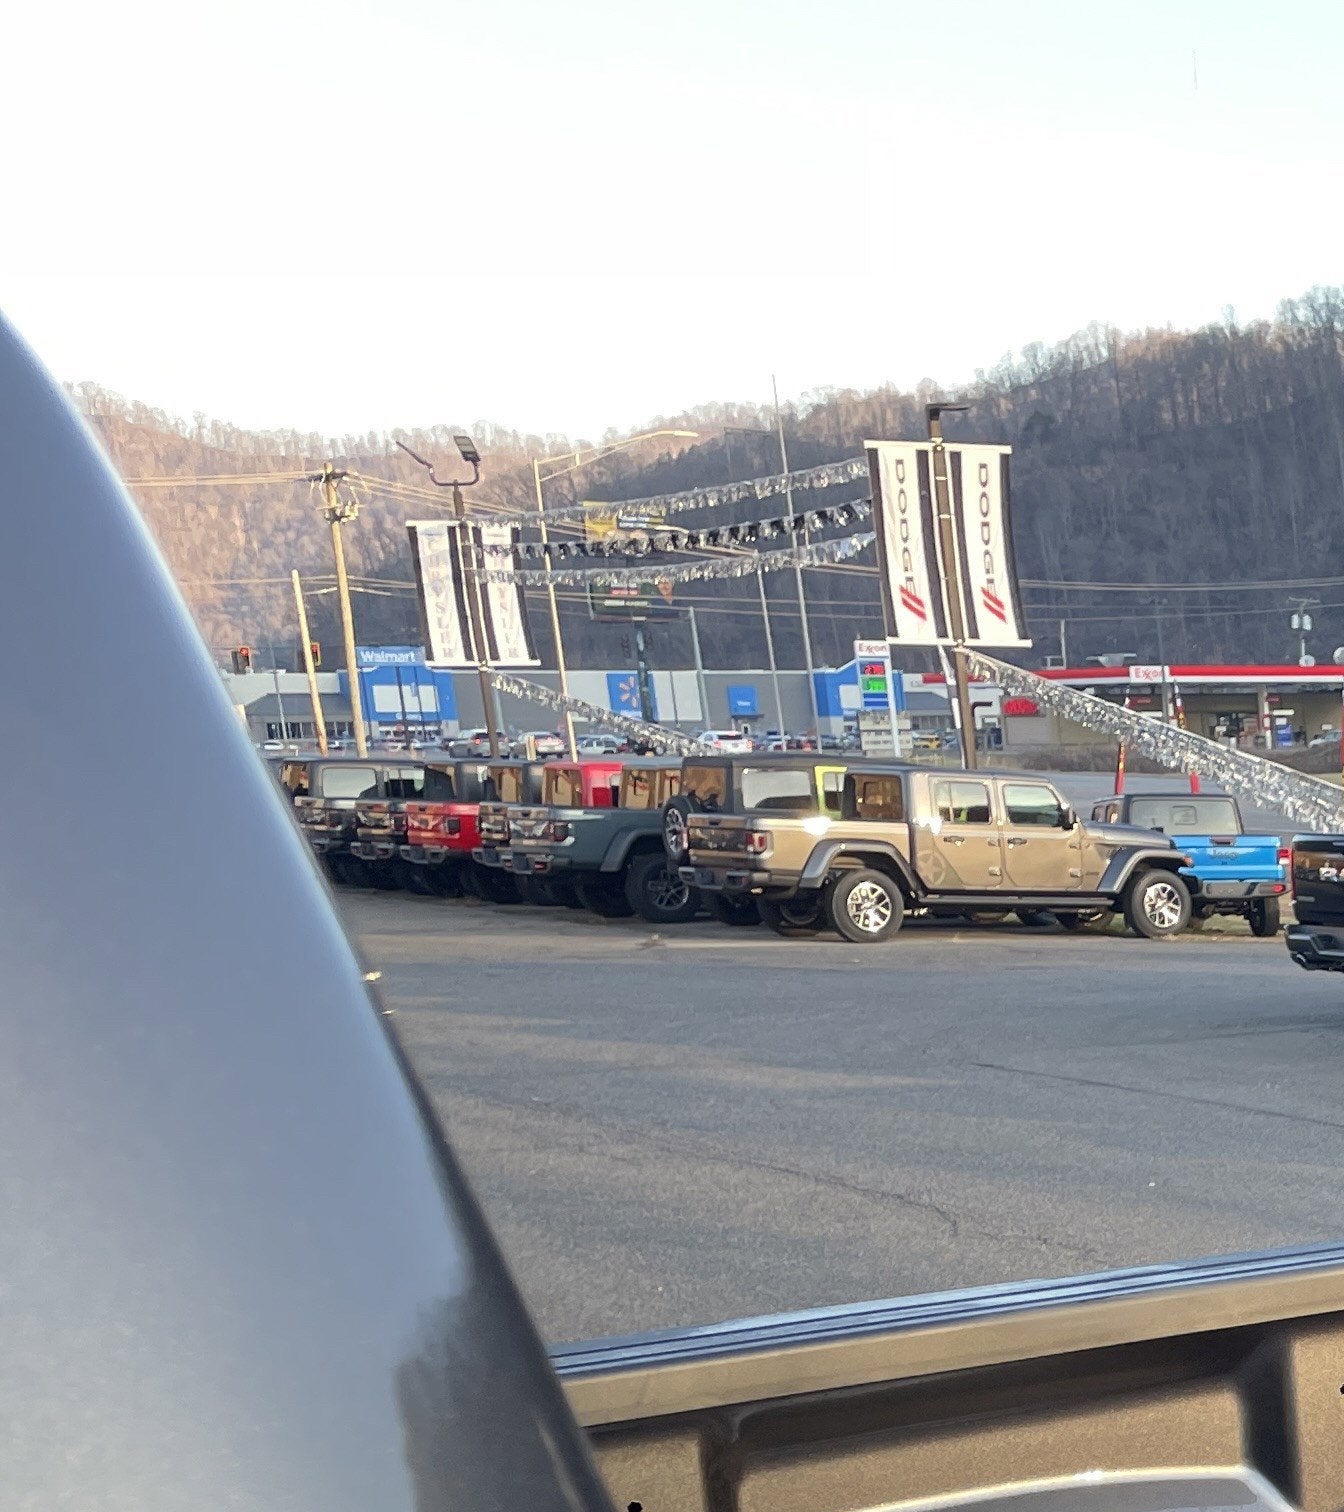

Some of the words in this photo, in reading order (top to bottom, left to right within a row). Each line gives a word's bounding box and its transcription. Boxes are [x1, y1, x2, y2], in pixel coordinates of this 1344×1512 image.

[895, 459, 916, 597] DODGE
[978, 463, 998, 598] DODGE
[858, 643, 888, 655] Exxon
[360, 650, 416, 663] Walmart
[1134, 667, 1163, 680] Exxo
